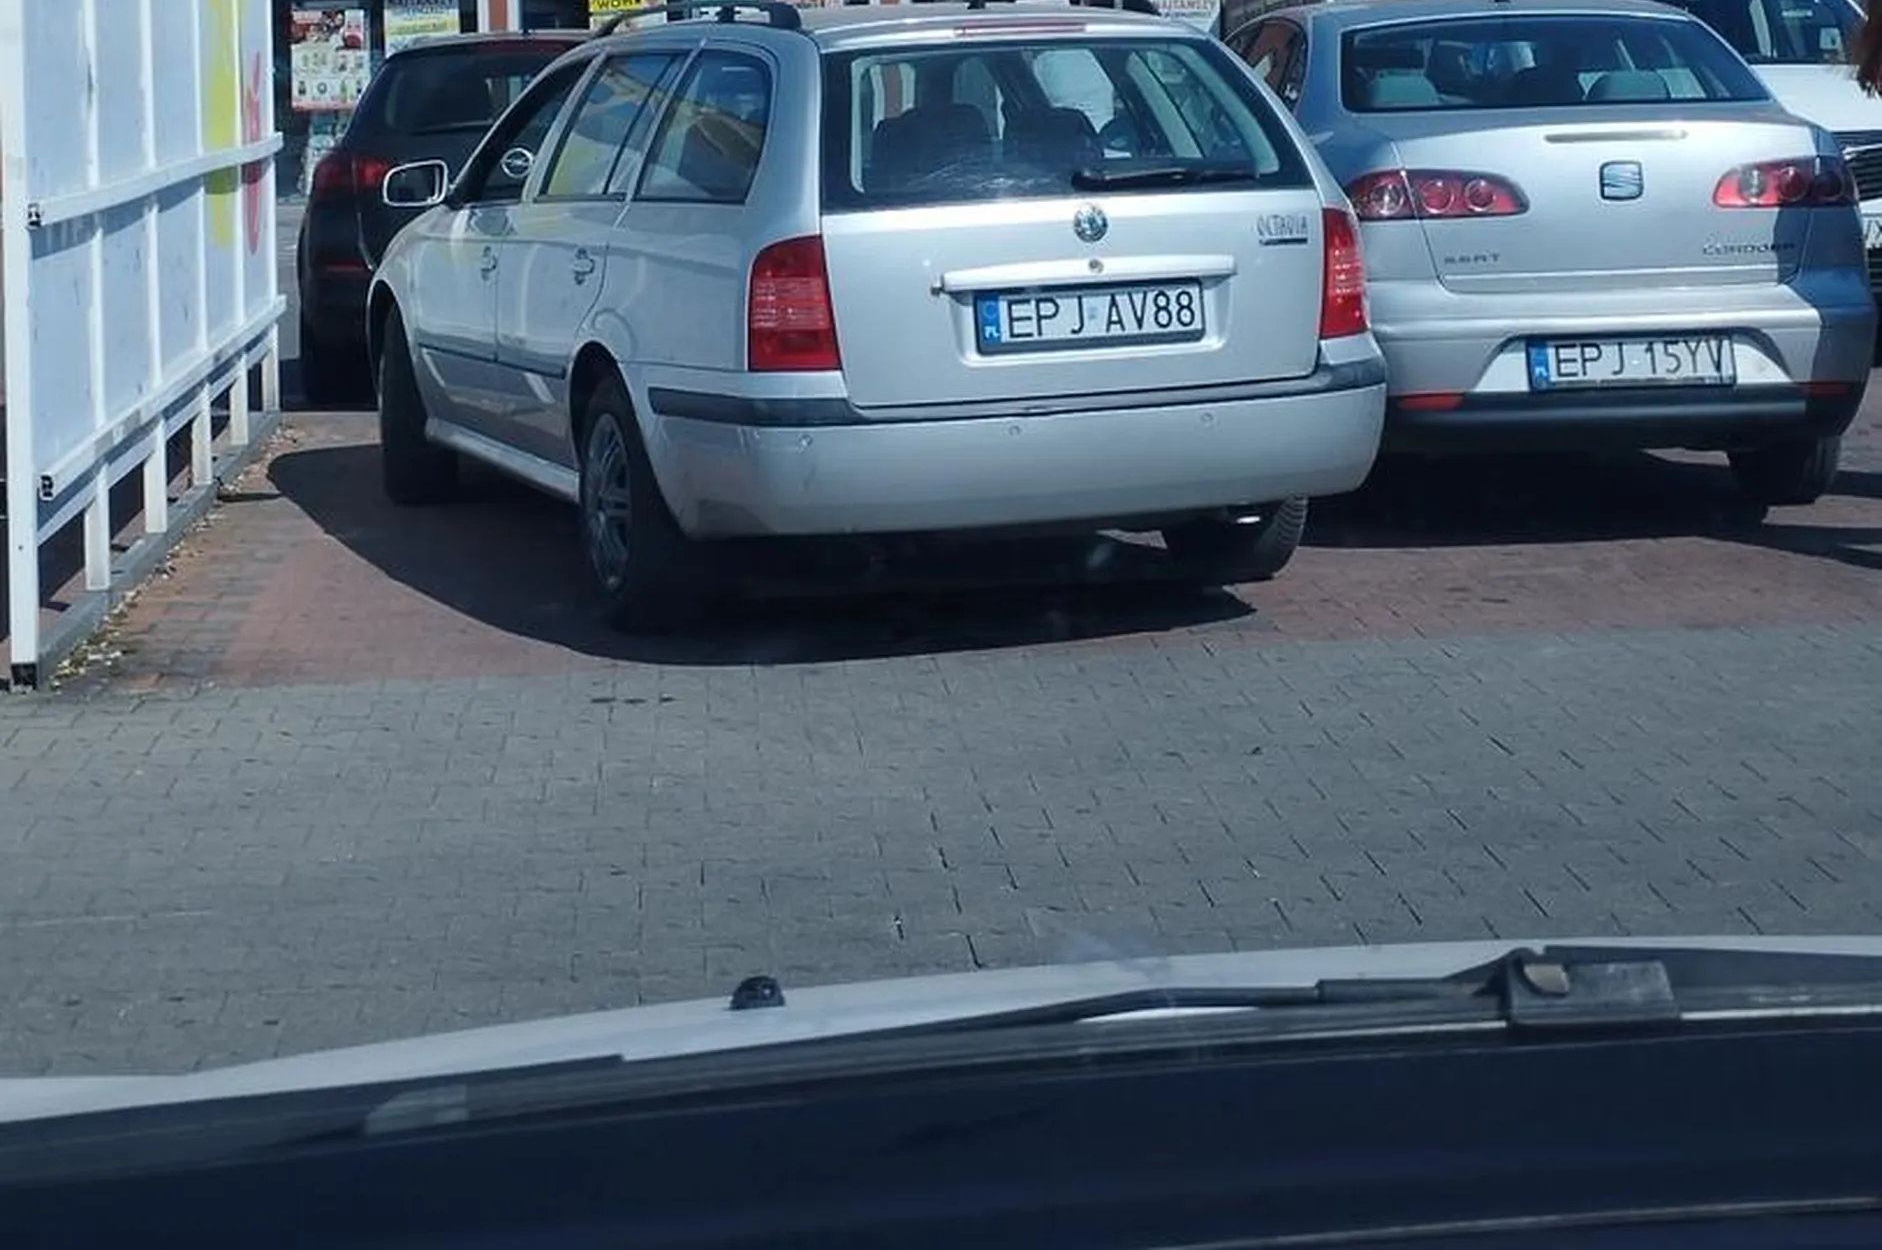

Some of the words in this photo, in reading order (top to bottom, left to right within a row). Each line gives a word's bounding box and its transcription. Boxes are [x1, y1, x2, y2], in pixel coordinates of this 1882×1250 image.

[1006, 295, 1085, 339] EPJ
[1106, 290, 1196, 332] AV88
[1554, 342, 1625, 377] EPJ
